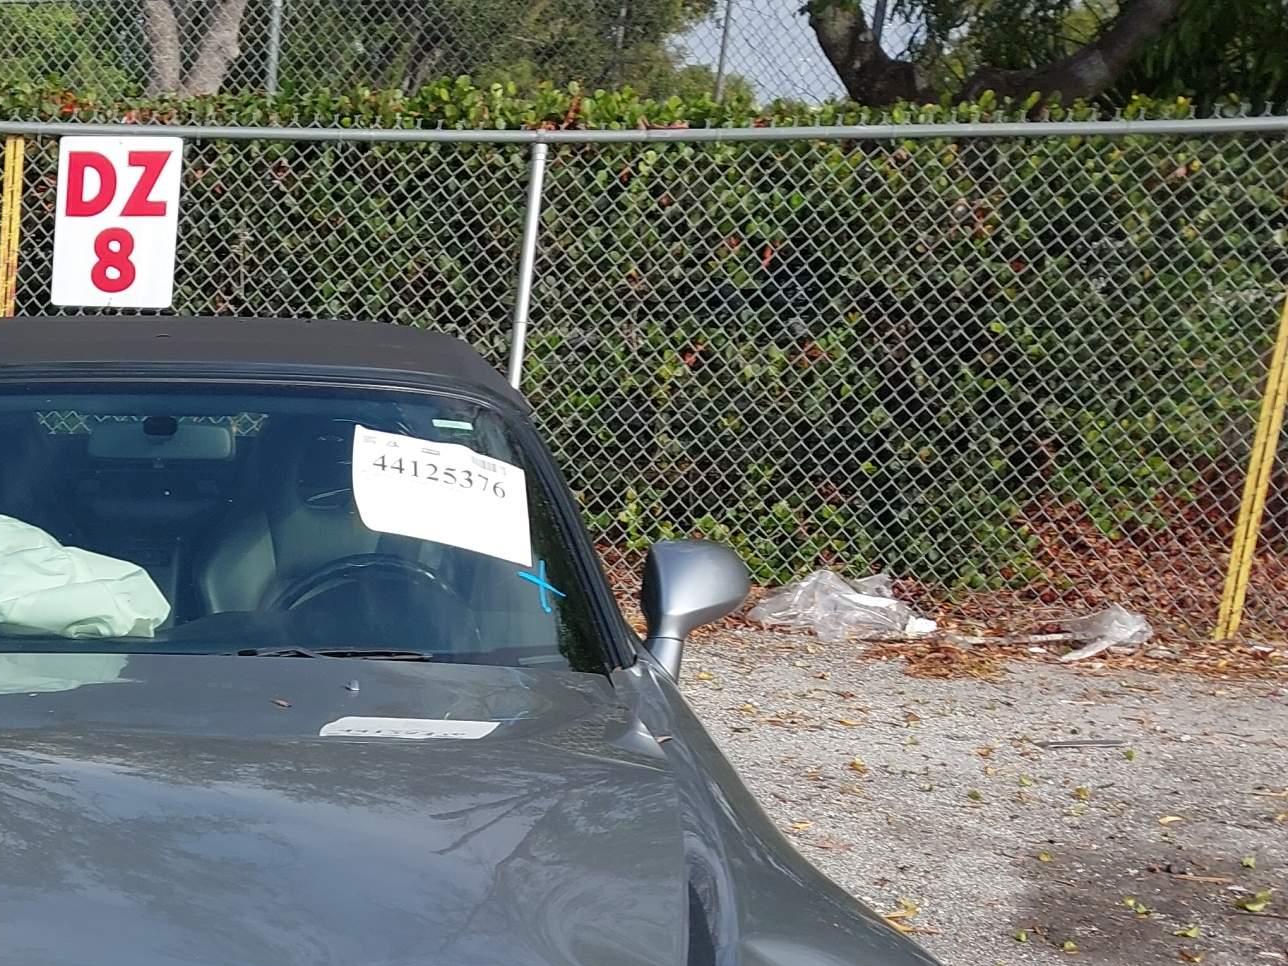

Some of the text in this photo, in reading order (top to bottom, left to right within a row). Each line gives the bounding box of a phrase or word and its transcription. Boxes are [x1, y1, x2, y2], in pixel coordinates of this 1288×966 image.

[65, 151, 172, 217] DZ
[90, 227, 136, 293] 8
[372, 454, 506, 498] 44125376
